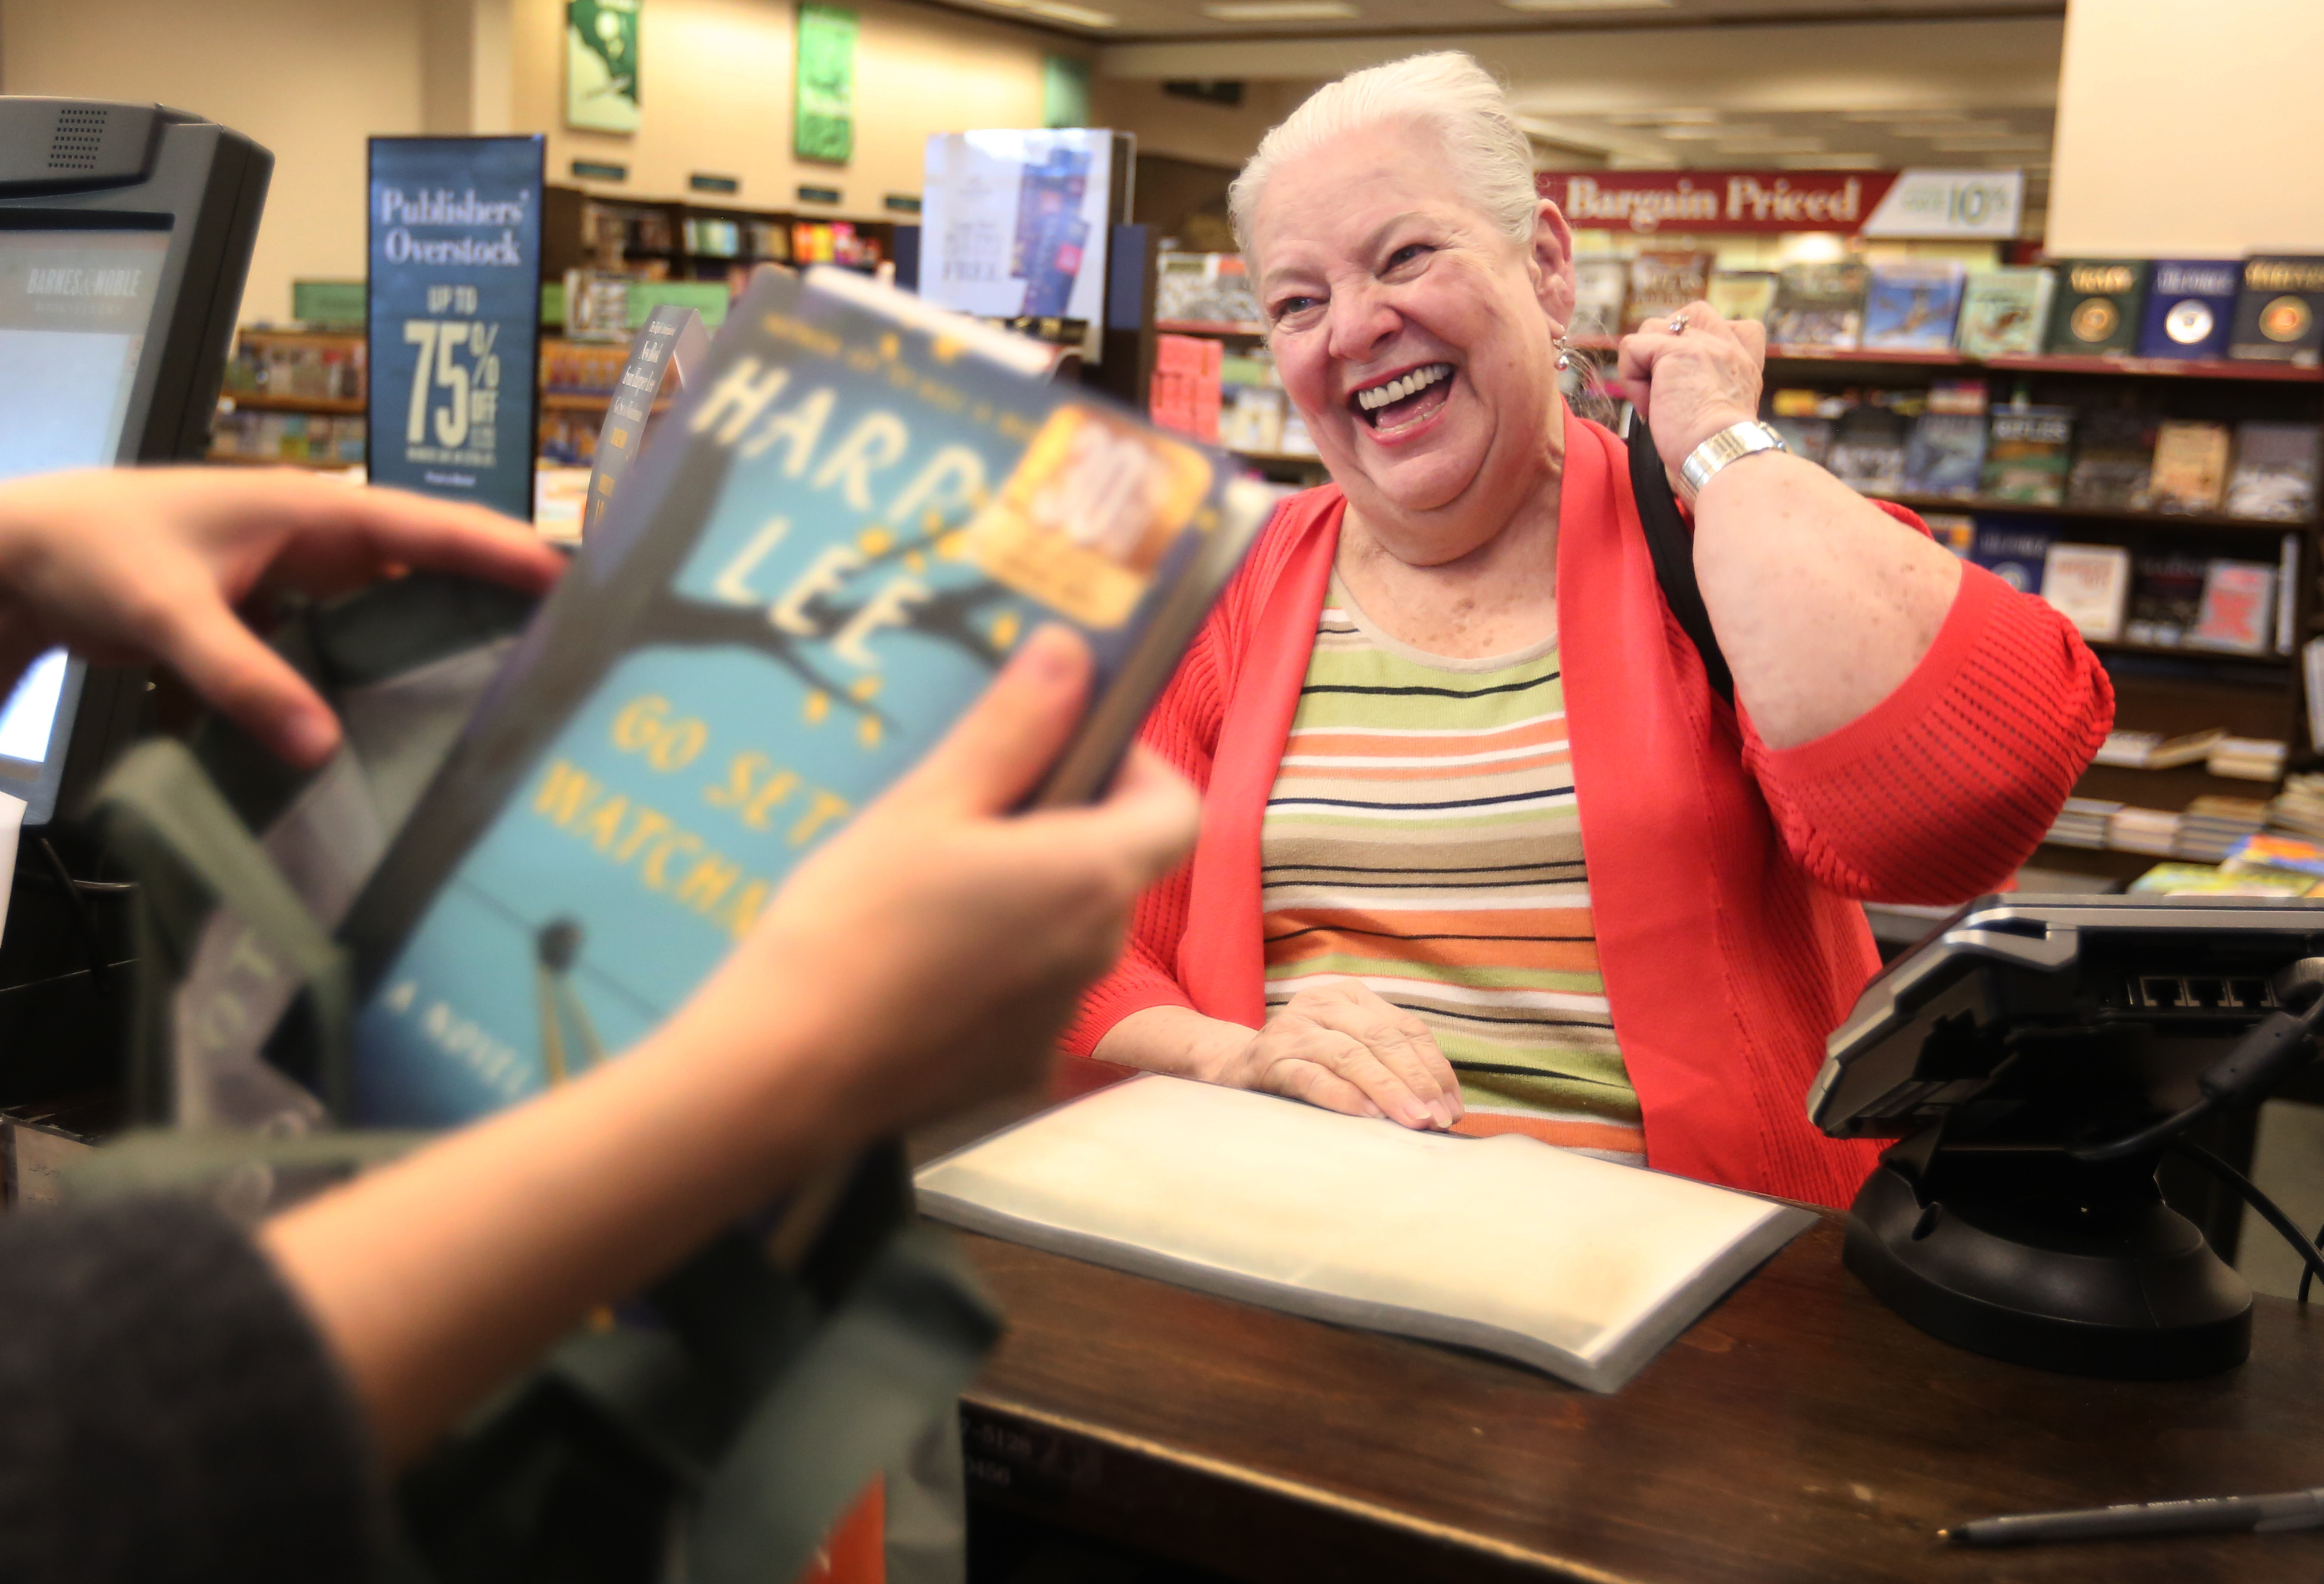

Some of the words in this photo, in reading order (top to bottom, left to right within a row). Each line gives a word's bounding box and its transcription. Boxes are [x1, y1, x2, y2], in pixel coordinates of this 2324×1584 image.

[380, 186, 530, 226] Publishers'
[1566, 174, 1719, 233] Bargain
[1725, 174, 1862, 222] Priced
[384, 227, 521, 266] Overstock
[427, 285, 453, 314] UP
[454, 285, 478, 315] TO
[471, 390, 500, 425] OFF
[713, 516, 934, 669] LEE
[611, 693, 708, 773] GO
[700, 749, 851, 848] SET
[385, 980, 416, 1013] A
